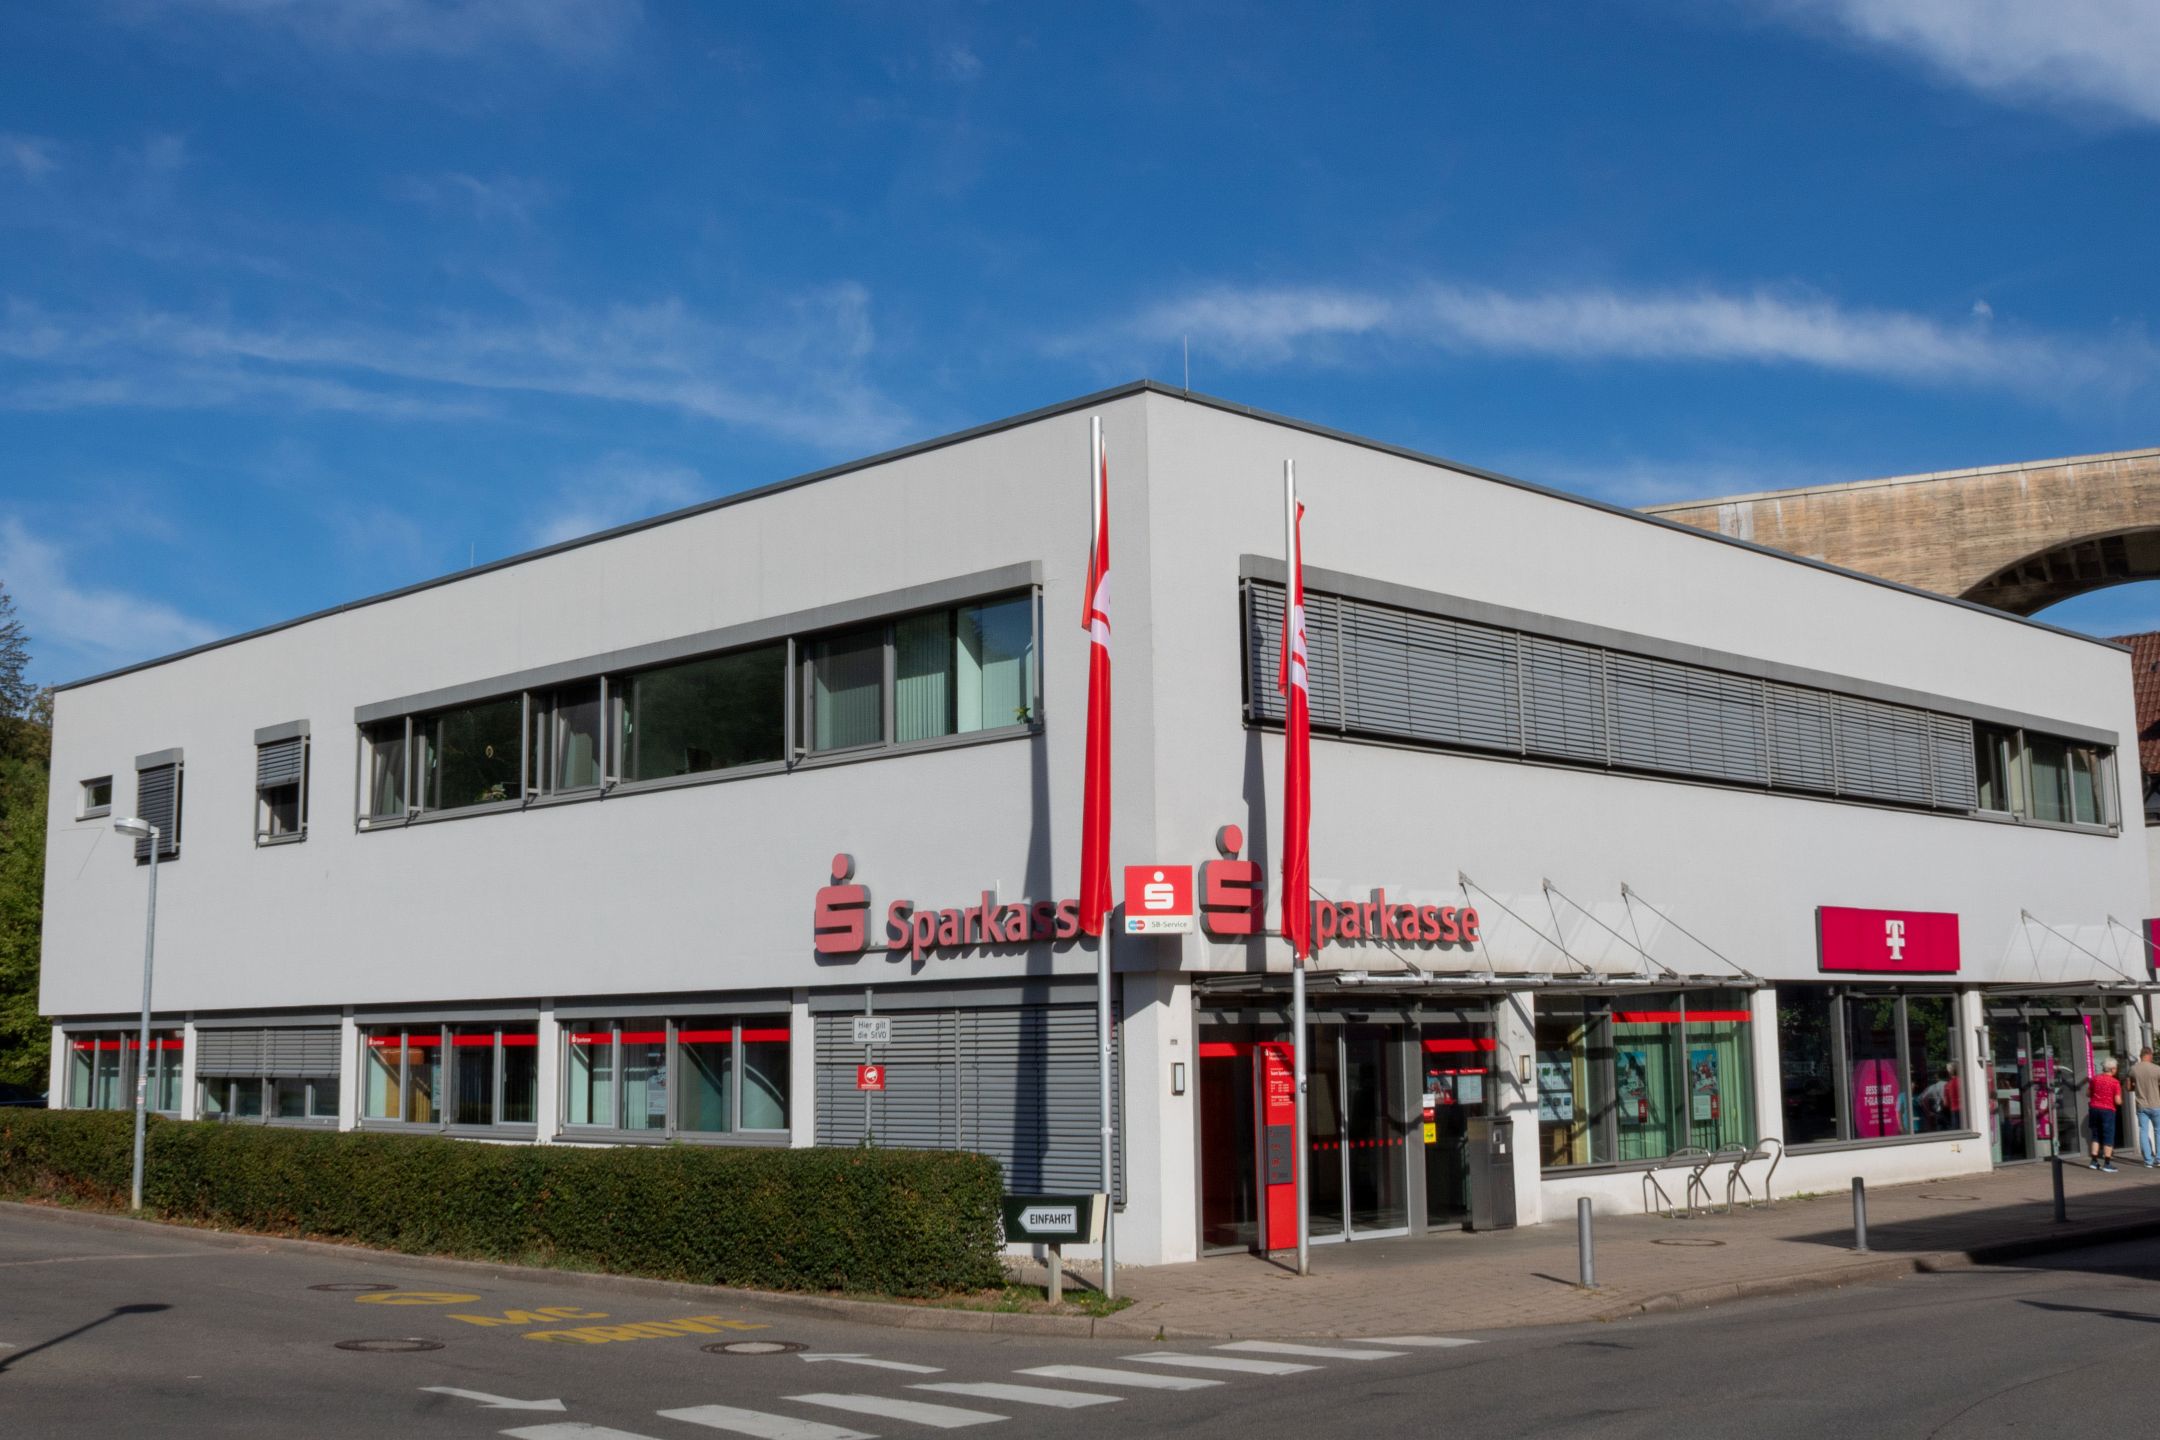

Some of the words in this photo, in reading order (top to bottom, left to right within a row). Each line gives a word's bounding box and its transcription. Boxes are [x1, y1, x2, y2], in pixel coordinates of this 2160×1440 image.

[887, 889, 1081, 961] Sparkass
[1311, 887, 1480, 950] parkasse
[857, 1031, 868, 1039] die
[858, 1021, 872, 1029] Hier
[875, 1021, 886, 1030] gilt
[1029, 1213, 1072, 1225] EINFAHRT
[521, 1314, 772, 1344] DRIVE
